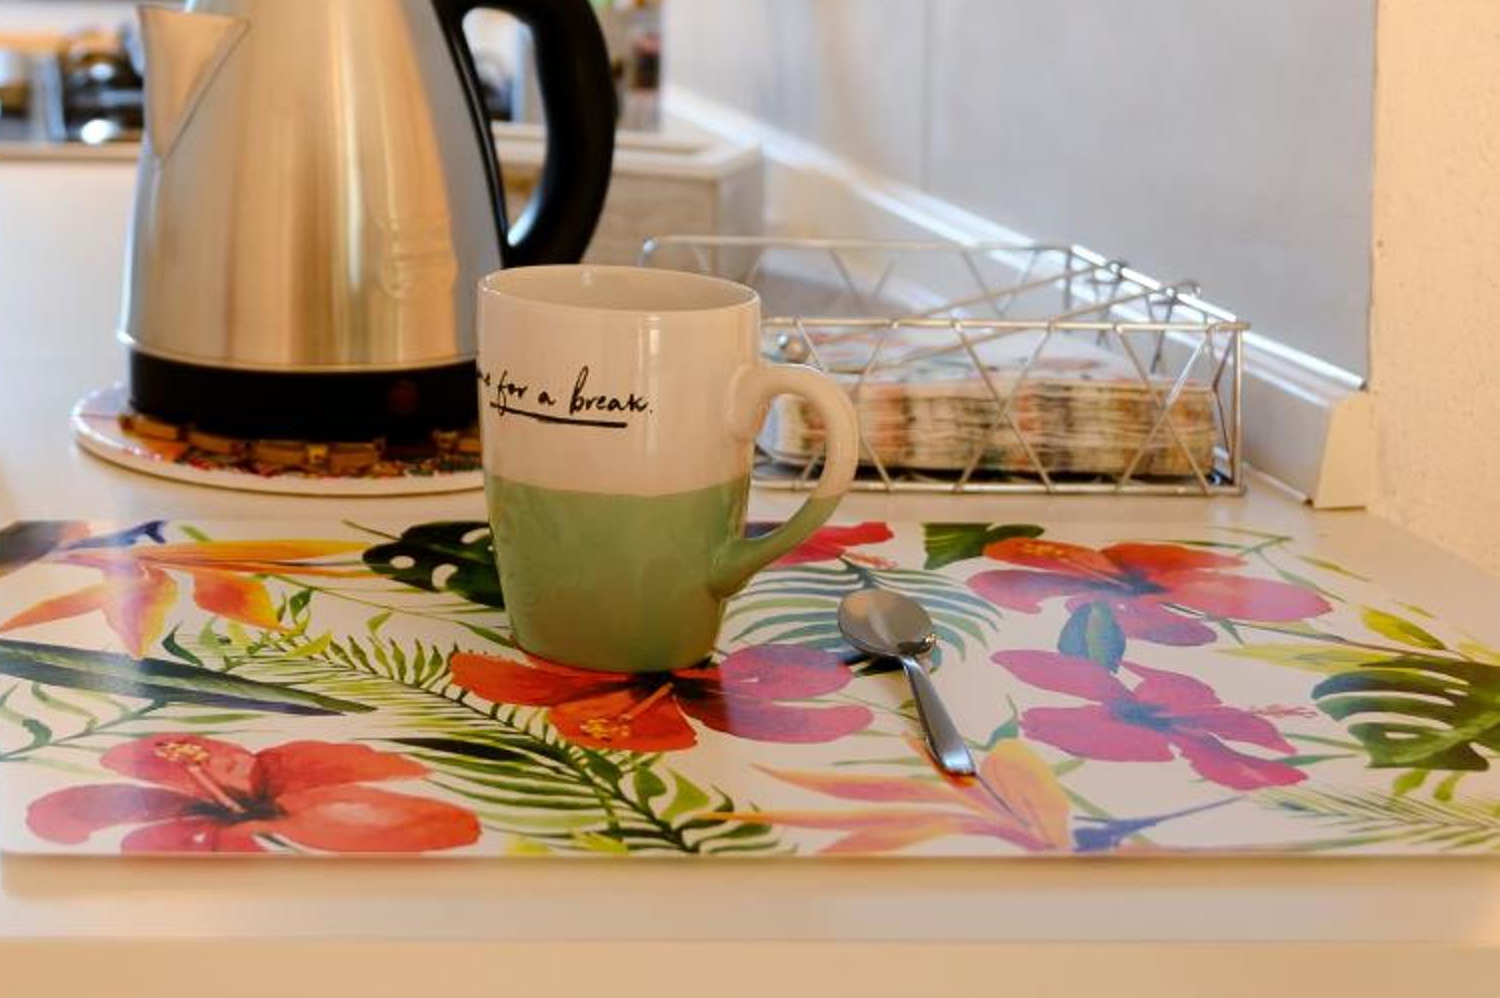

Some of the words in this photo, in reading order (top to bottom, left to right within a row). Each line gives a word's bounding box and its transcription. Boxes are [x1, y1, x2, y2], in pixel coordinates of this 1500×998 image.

[498, 370, 528, 415] for
[538, 391, 556, 405] a
[569, 366, 653, 414] break.
